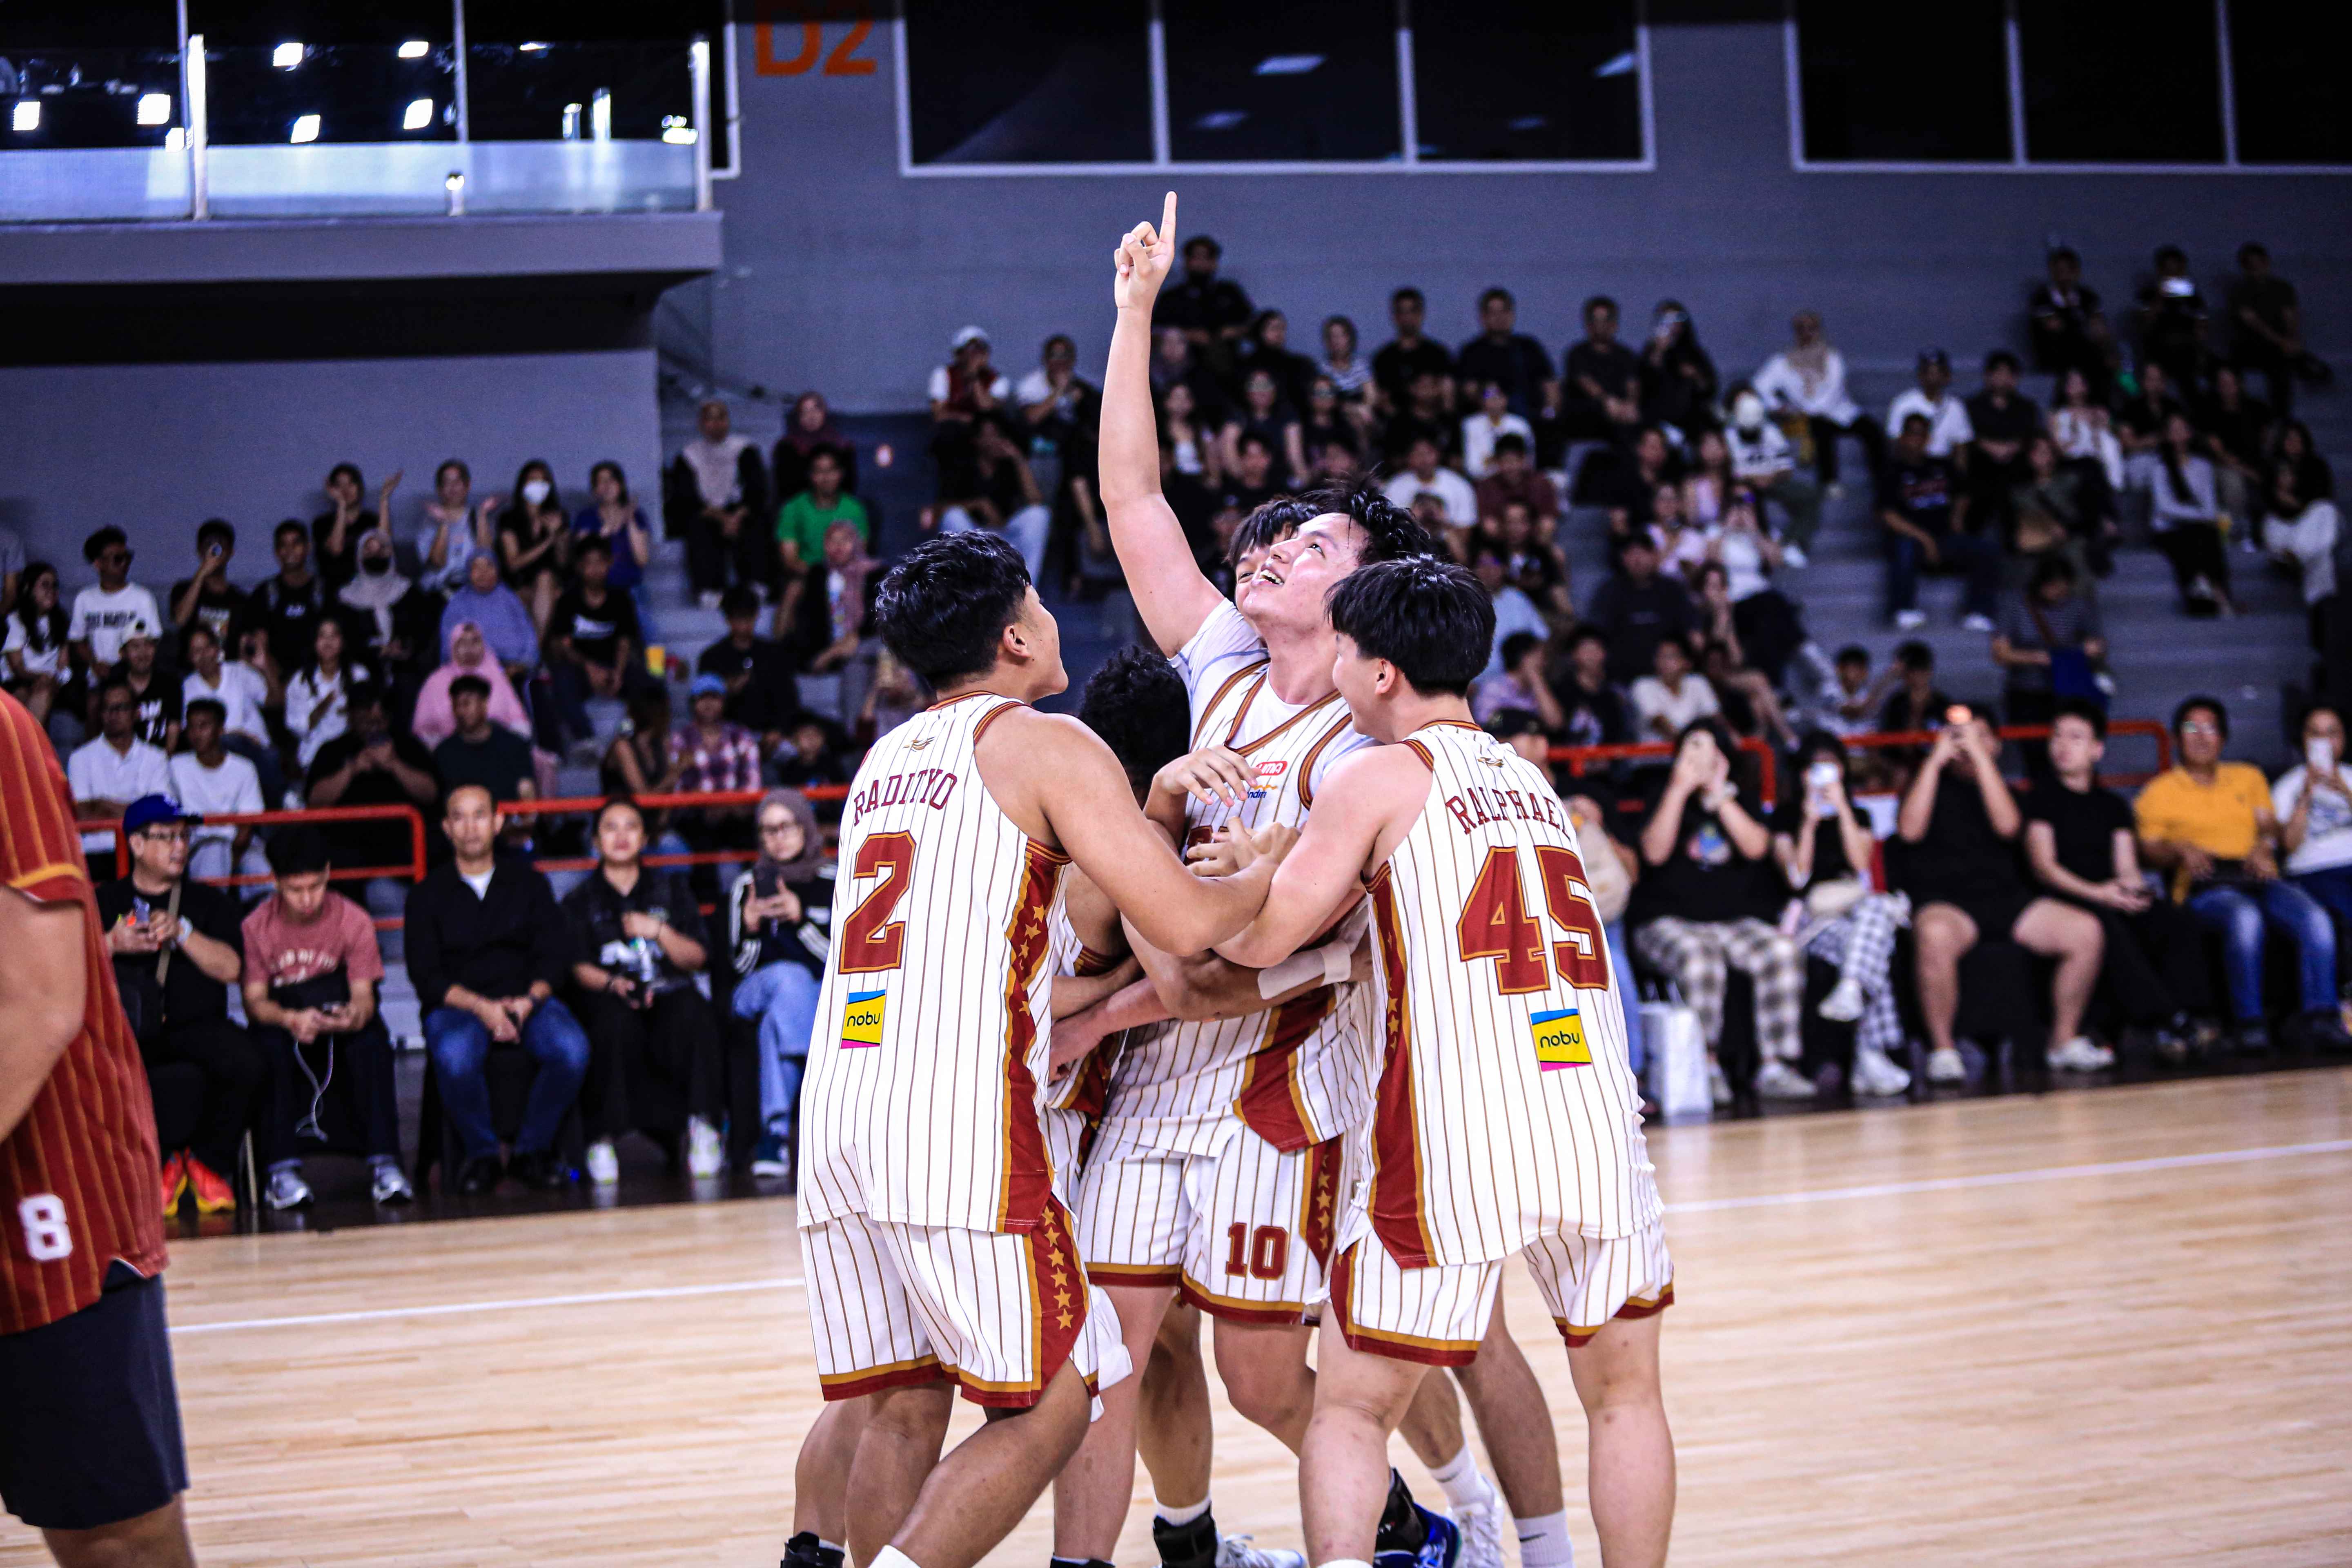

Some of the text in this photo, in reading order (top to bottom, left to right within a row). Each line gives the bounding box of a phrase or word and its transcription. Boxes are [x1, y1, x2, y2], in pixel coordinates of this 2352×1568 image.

[755, 0, 877, 76] D2
[854, 768, 958, 827] RADITYO
[838, 829, 916, 974] 2
[1457, 845, 1609, 995] 45
[846, 1011, 880, 1027] nobu
[1540, 1030, 1580, 1048] nobu
[18, 1192, 74, 1262] 8
[1225, 1223, 1288, 1280] 10
